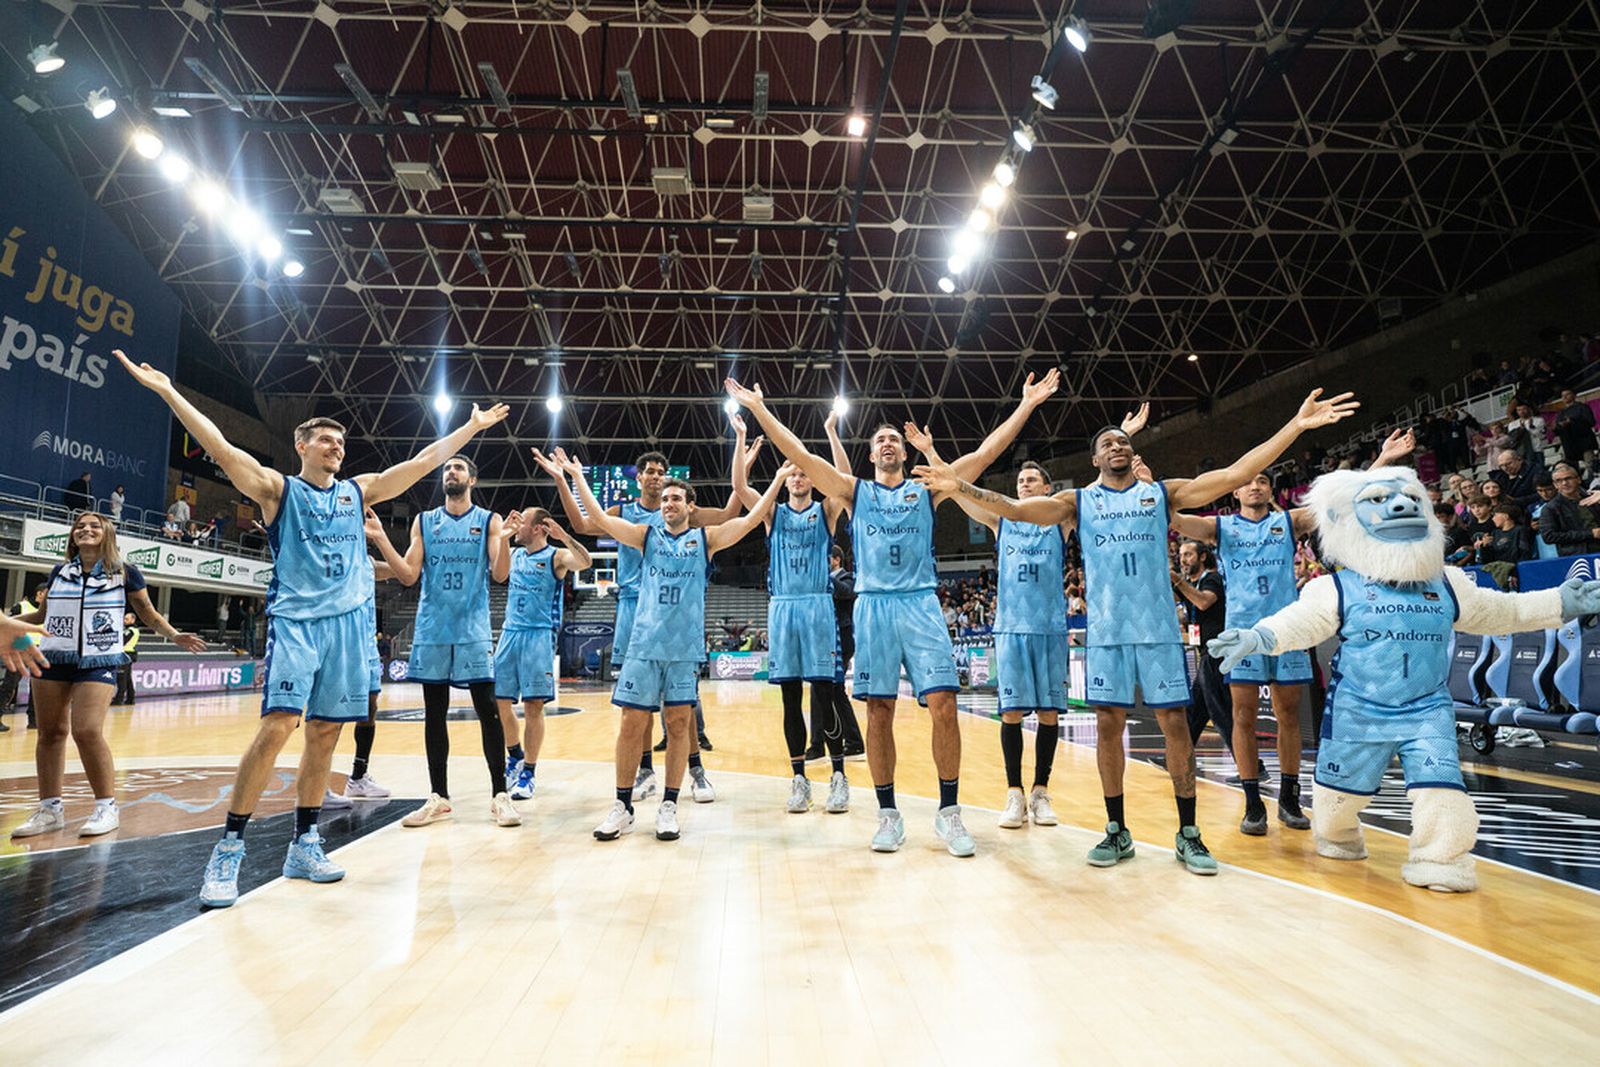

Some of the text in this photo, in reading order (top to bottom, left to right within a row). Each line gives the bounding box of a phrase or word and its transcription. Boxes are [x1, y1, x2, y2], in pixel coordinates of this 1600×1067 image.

[24, 246, 136, 337] juga
[0, 315, 109, 389] país
[53, 435, 147, 477] MORABANC
[609, 480, 628, 489] 112
[1101, 509, 1157, 521] MORABANC
[36, 537, 66, 552] FINISHE
[312, 533, 357, 544] Andorra
[1107, 530, 1156, 543] Andorra
[322, 552, 345, 578] 13
[889, 544, 901, 566] 9
[1122, 552, 1138, 577] 11
[790, 558, 809, 574] 44
[1018, 563, 1039, 583] 24
[442, 571, 463, 590] 33
[1257, 575, 1270, 595] 8
[659, 585, 681, 605] 20
[1375, 604, 1445, 615] MORABANC
[49, 617, 74, 628] MAI
[1384, 630, 1443, 642] Andorra
[1402, 652, 1409, 679] 1
[132, 664, 242, 689] FORA LÍMITS
